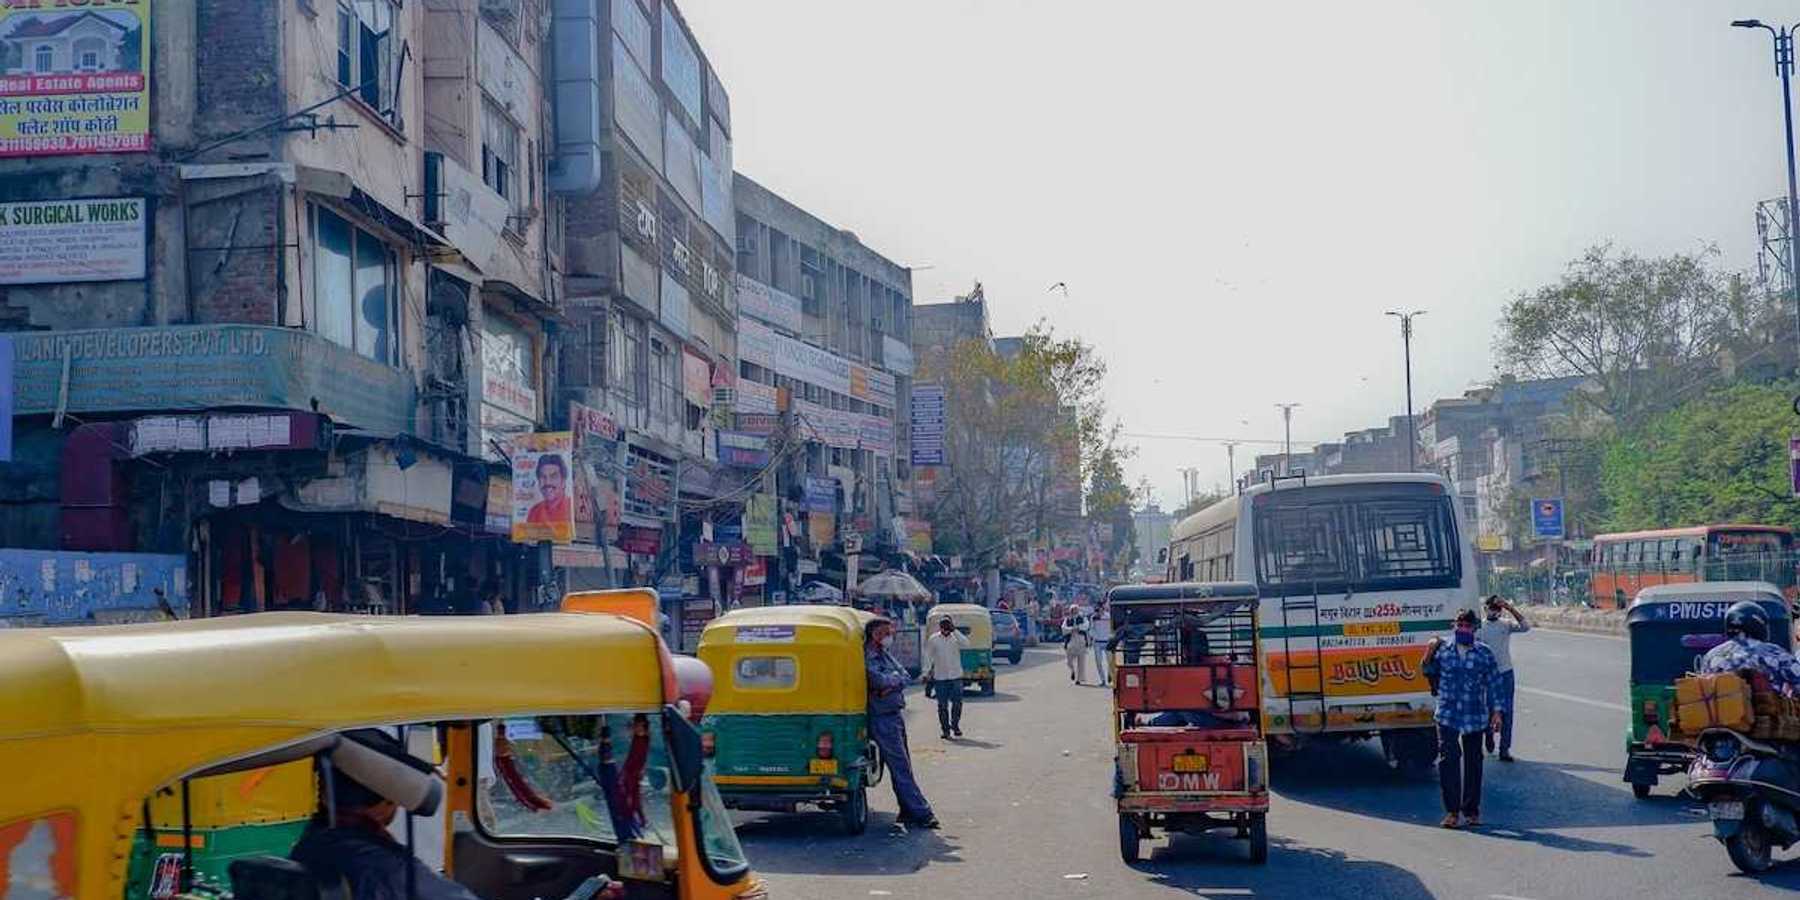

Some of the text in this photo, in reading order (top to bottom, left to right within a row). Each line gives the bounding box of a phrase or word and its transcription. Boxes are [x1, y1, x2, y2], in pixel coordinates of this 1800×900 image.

[35, 77, 83, 90] Estate
[86, 74, 139, 88] Agents
[13, 204, 84, 225] SURGICAL
[87, 202, 139, 221] WORKS
[73, 335, 184, 359] DEVELOPERS
